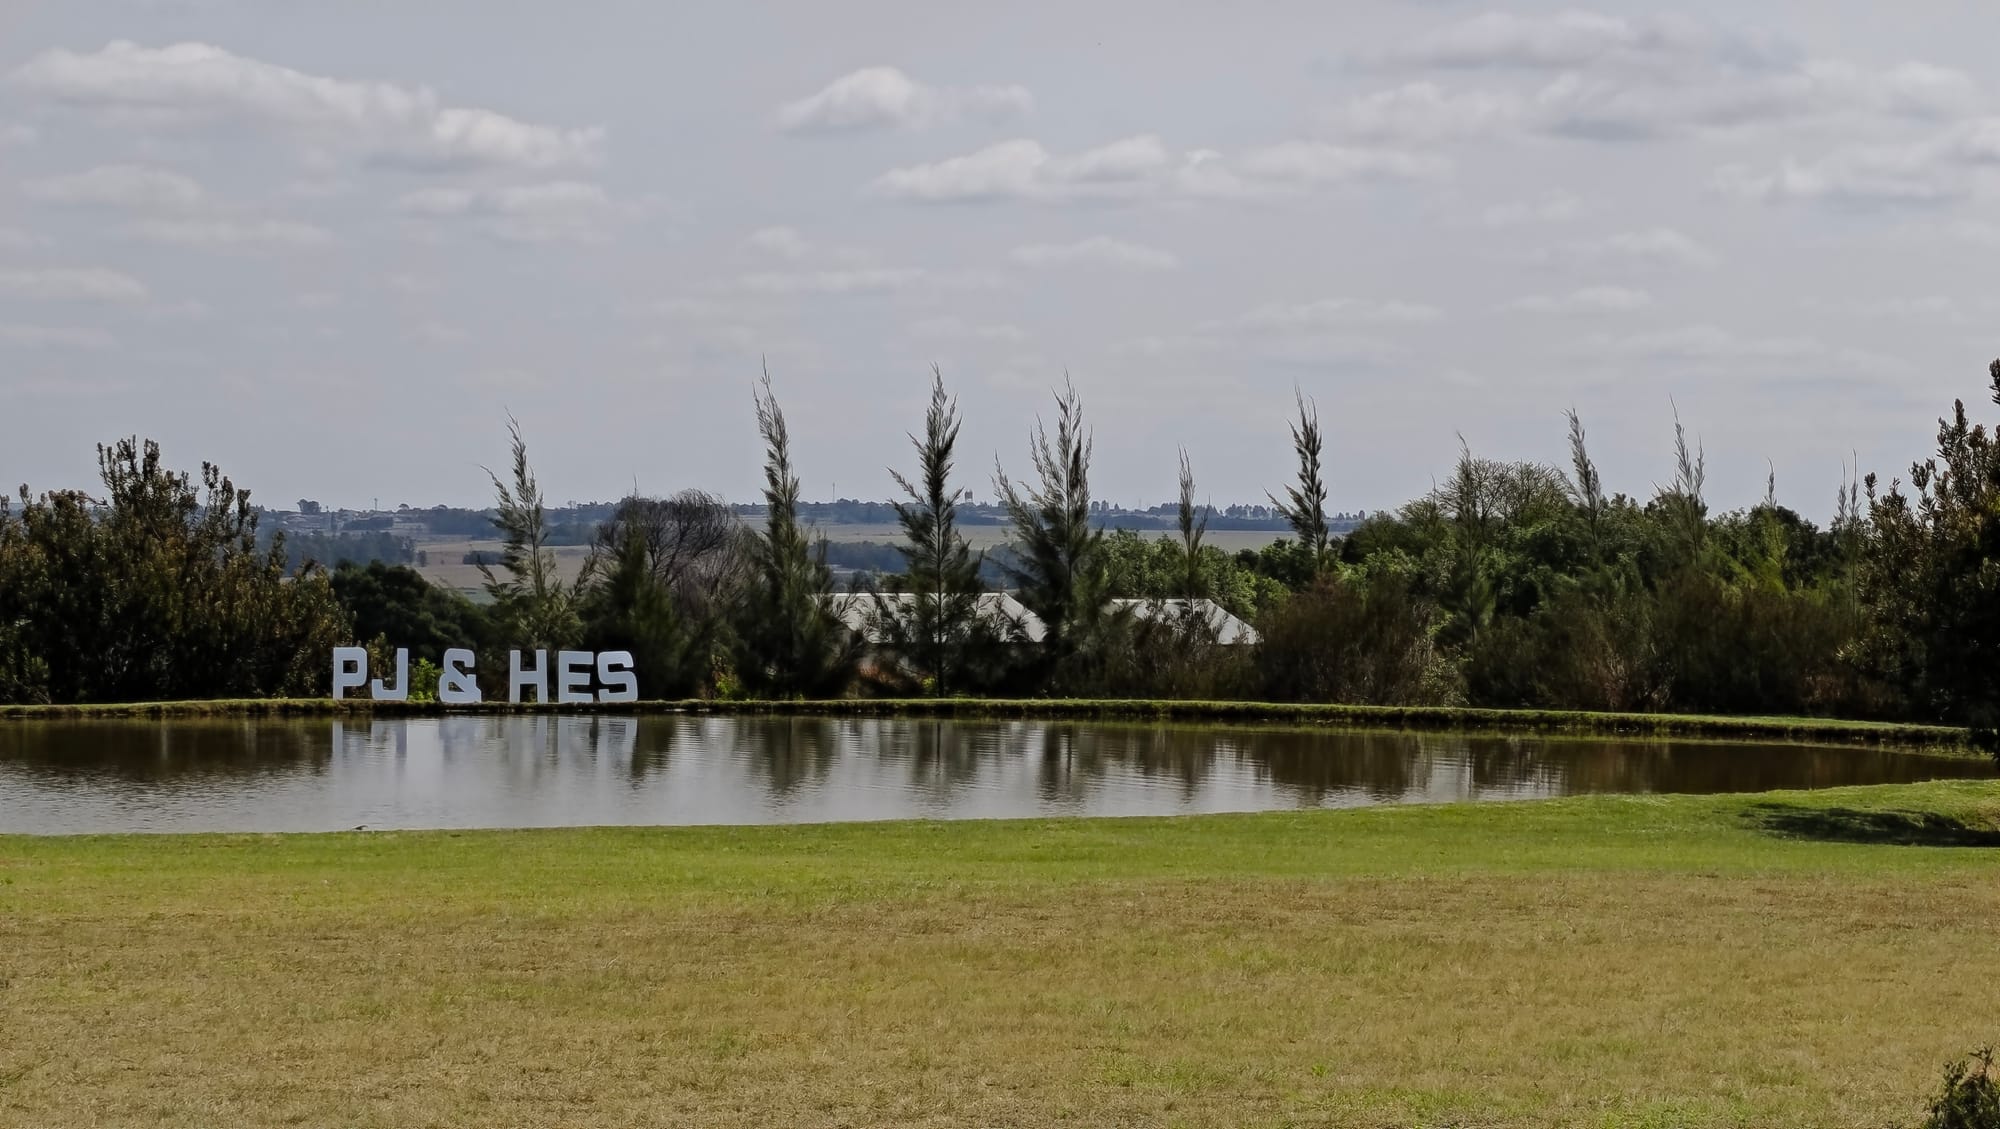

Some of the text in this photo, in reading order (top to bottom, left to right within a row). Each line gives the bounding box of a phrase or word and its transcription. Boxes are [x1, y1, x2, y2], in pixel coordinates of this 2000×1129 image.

[332, 646, 638, 703] PJ & HES
